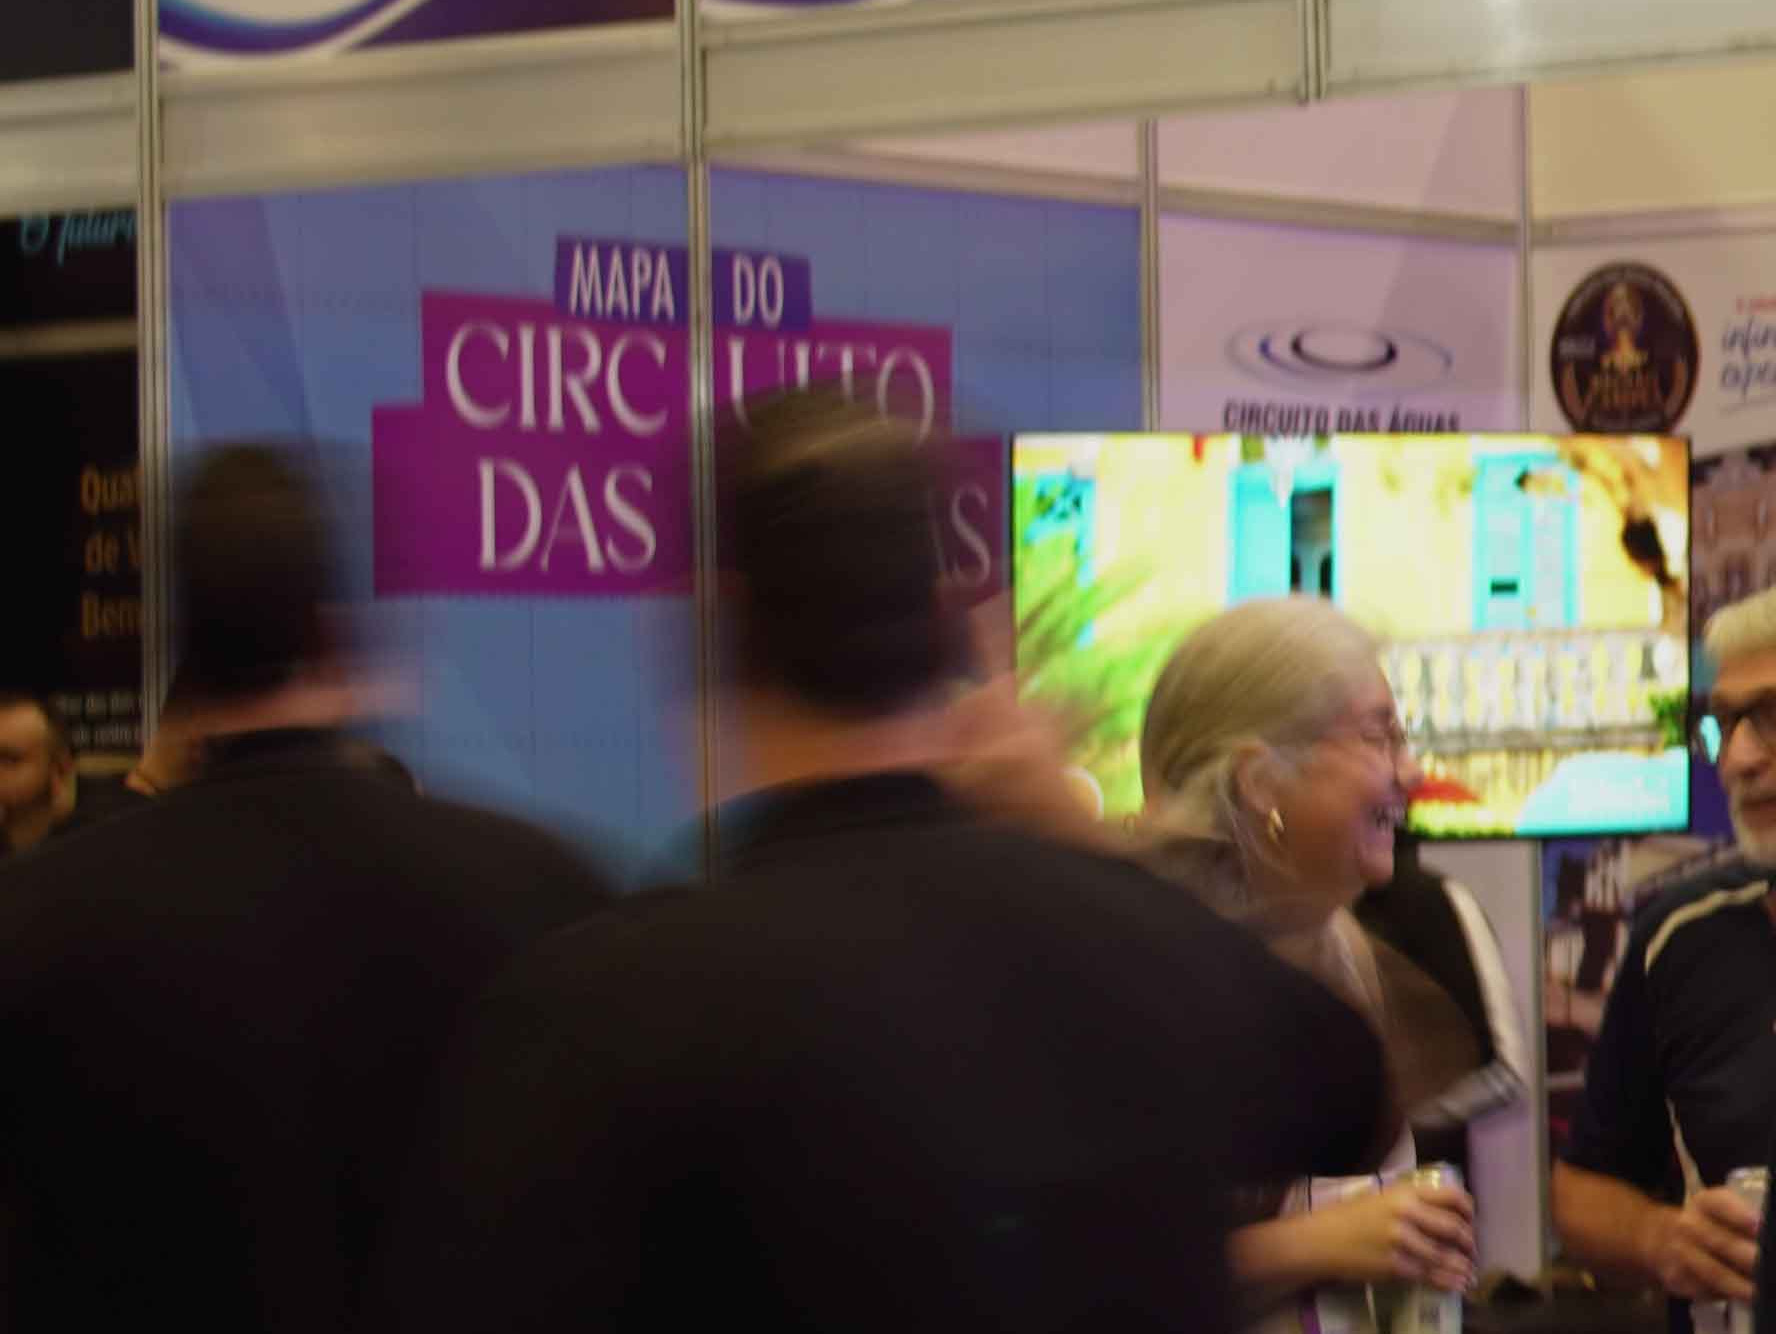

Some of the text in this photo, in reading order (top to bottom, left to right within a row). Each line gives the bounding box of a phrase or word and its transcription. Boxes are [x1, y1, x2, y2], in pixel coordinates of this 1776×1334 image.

[569, 241, 784, 326] MAPA DO
[478, 457, 658, 574] DAS
